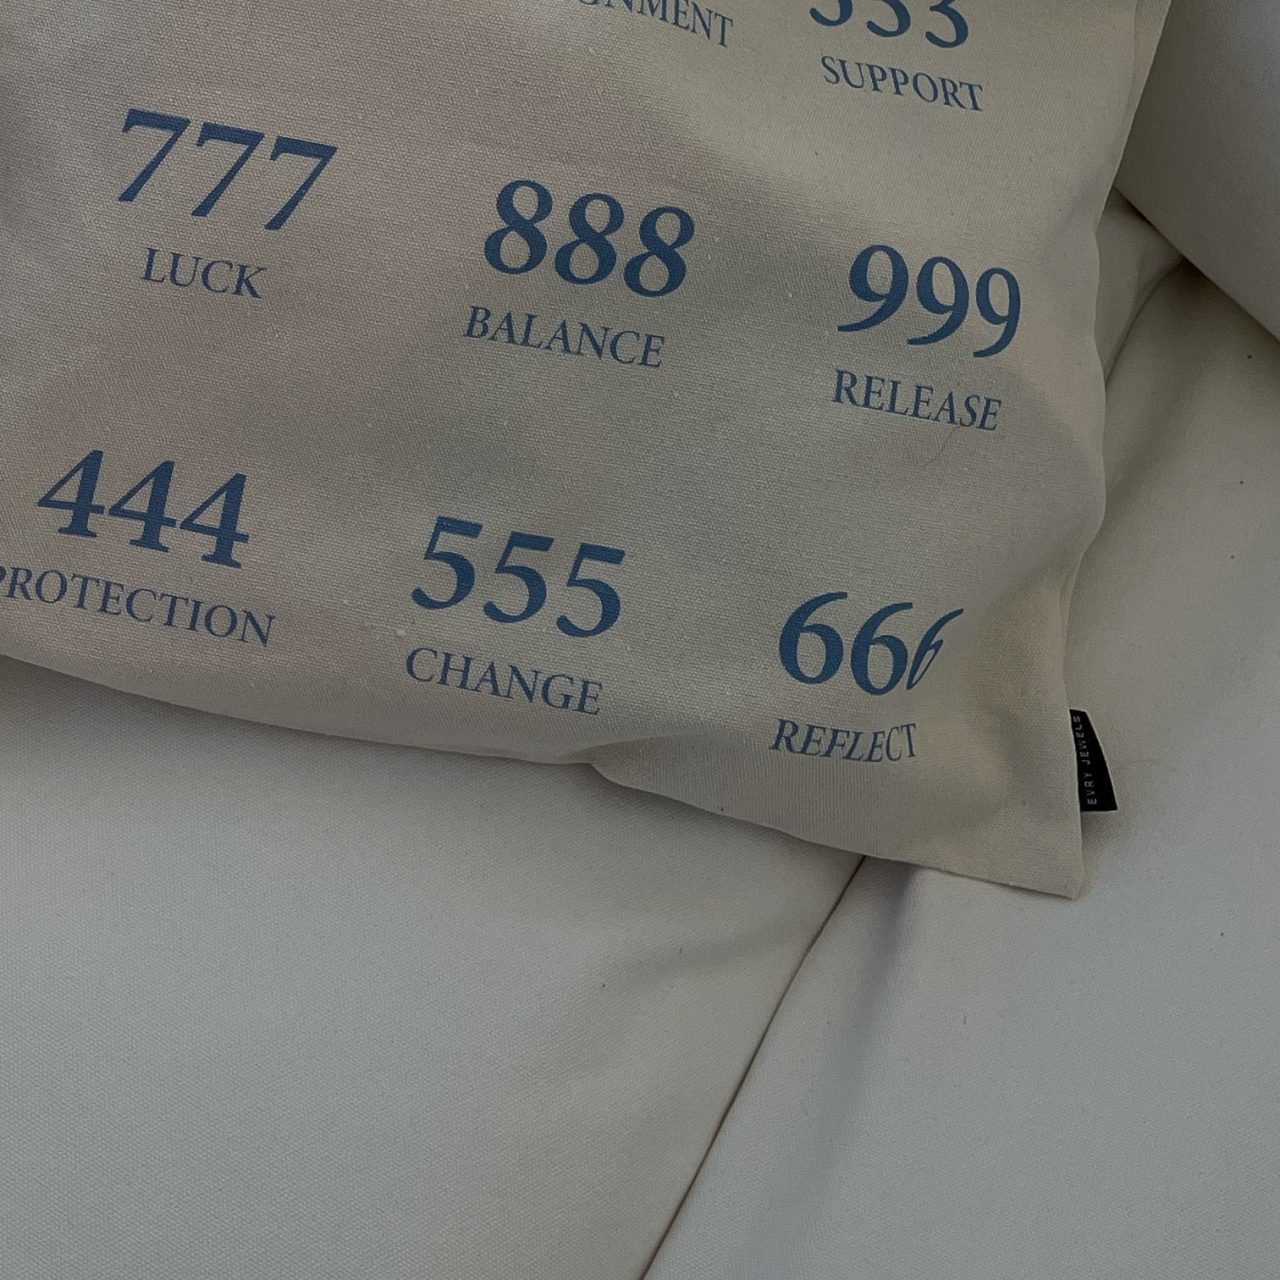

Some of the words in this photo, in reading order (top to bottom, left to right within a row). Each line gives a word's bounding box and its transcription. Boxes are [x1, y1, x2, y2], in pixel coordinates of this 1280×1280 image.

[820, 54, 984, 114] SUPPORT
[118, 107, 337, 231] 777
[483, 179, 696, 298] 888
[142, 246, 263, 299] LUCK
[836, 244, 1022, 358] 999
[463, 304, 665, 369] BALANCE
[831, 368, 1001, 432] RELEASE
[37, 449, 250, 568] 444
[411, 515, 626, 638] 555
[404, 645, 603, 716] CHANGE
[769, 718, 917, 763] REFLECT
[1073, 715, 1090, 766] JEWELS
[1083, 770, 1098, 806] EVRY
